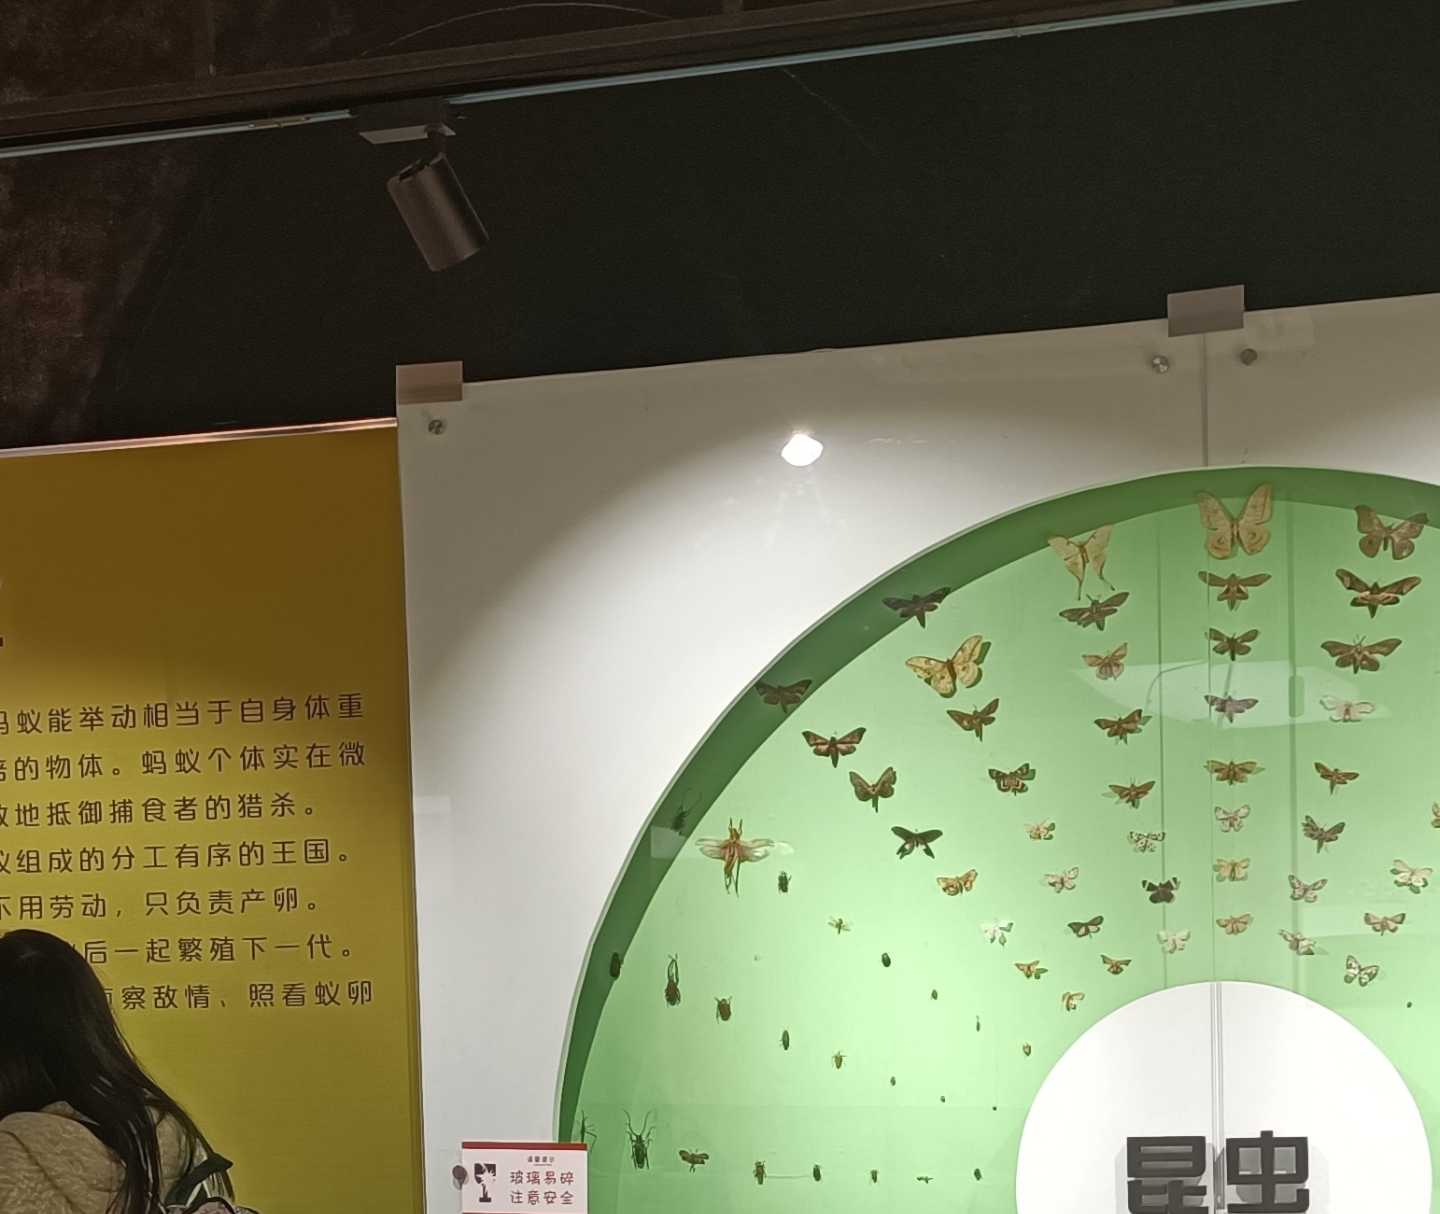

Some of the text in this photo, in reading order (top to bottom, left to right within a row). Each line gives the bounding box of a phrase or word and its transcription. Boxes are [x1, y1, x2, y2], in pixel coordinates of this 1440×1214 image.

[510, 1170, 574, 1185] 玻璃易碎
[510, 1189, 574, 1205] 注意安全
